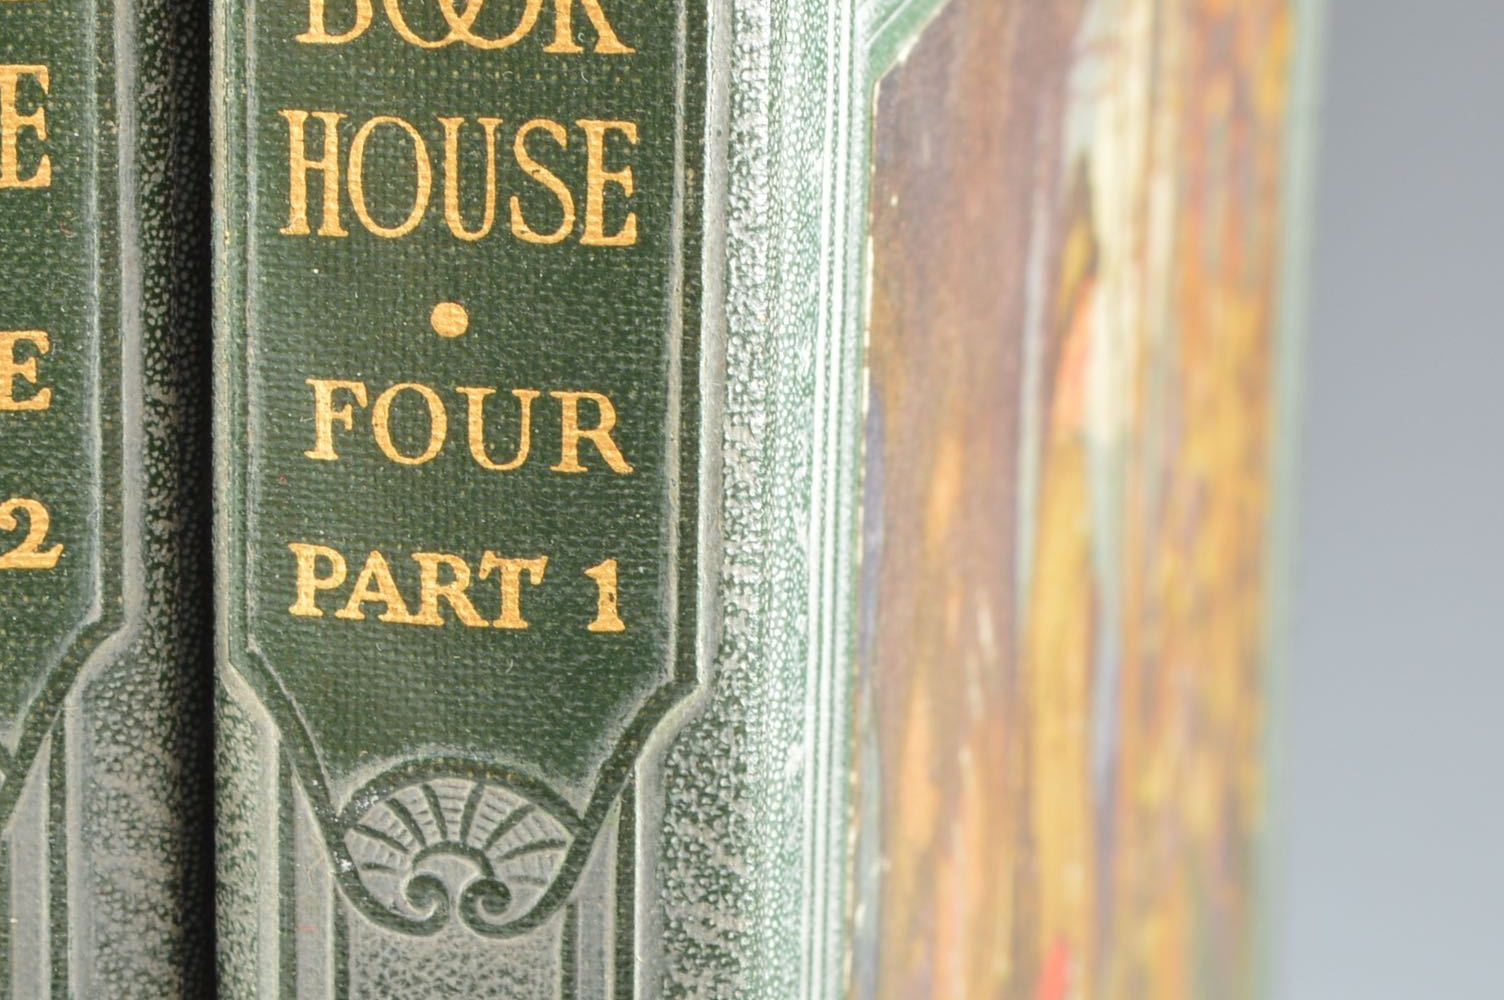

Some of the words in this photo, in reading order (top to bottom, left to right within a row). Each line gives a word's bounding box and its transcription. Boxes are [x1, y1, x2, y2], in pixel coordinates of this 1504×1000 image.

[278, 109, 639, 246] HOUSE
[304, 378, 633, 473] FOUR
[288, 542, 548, 629] PART
[585, 558, 625, 632] 1
